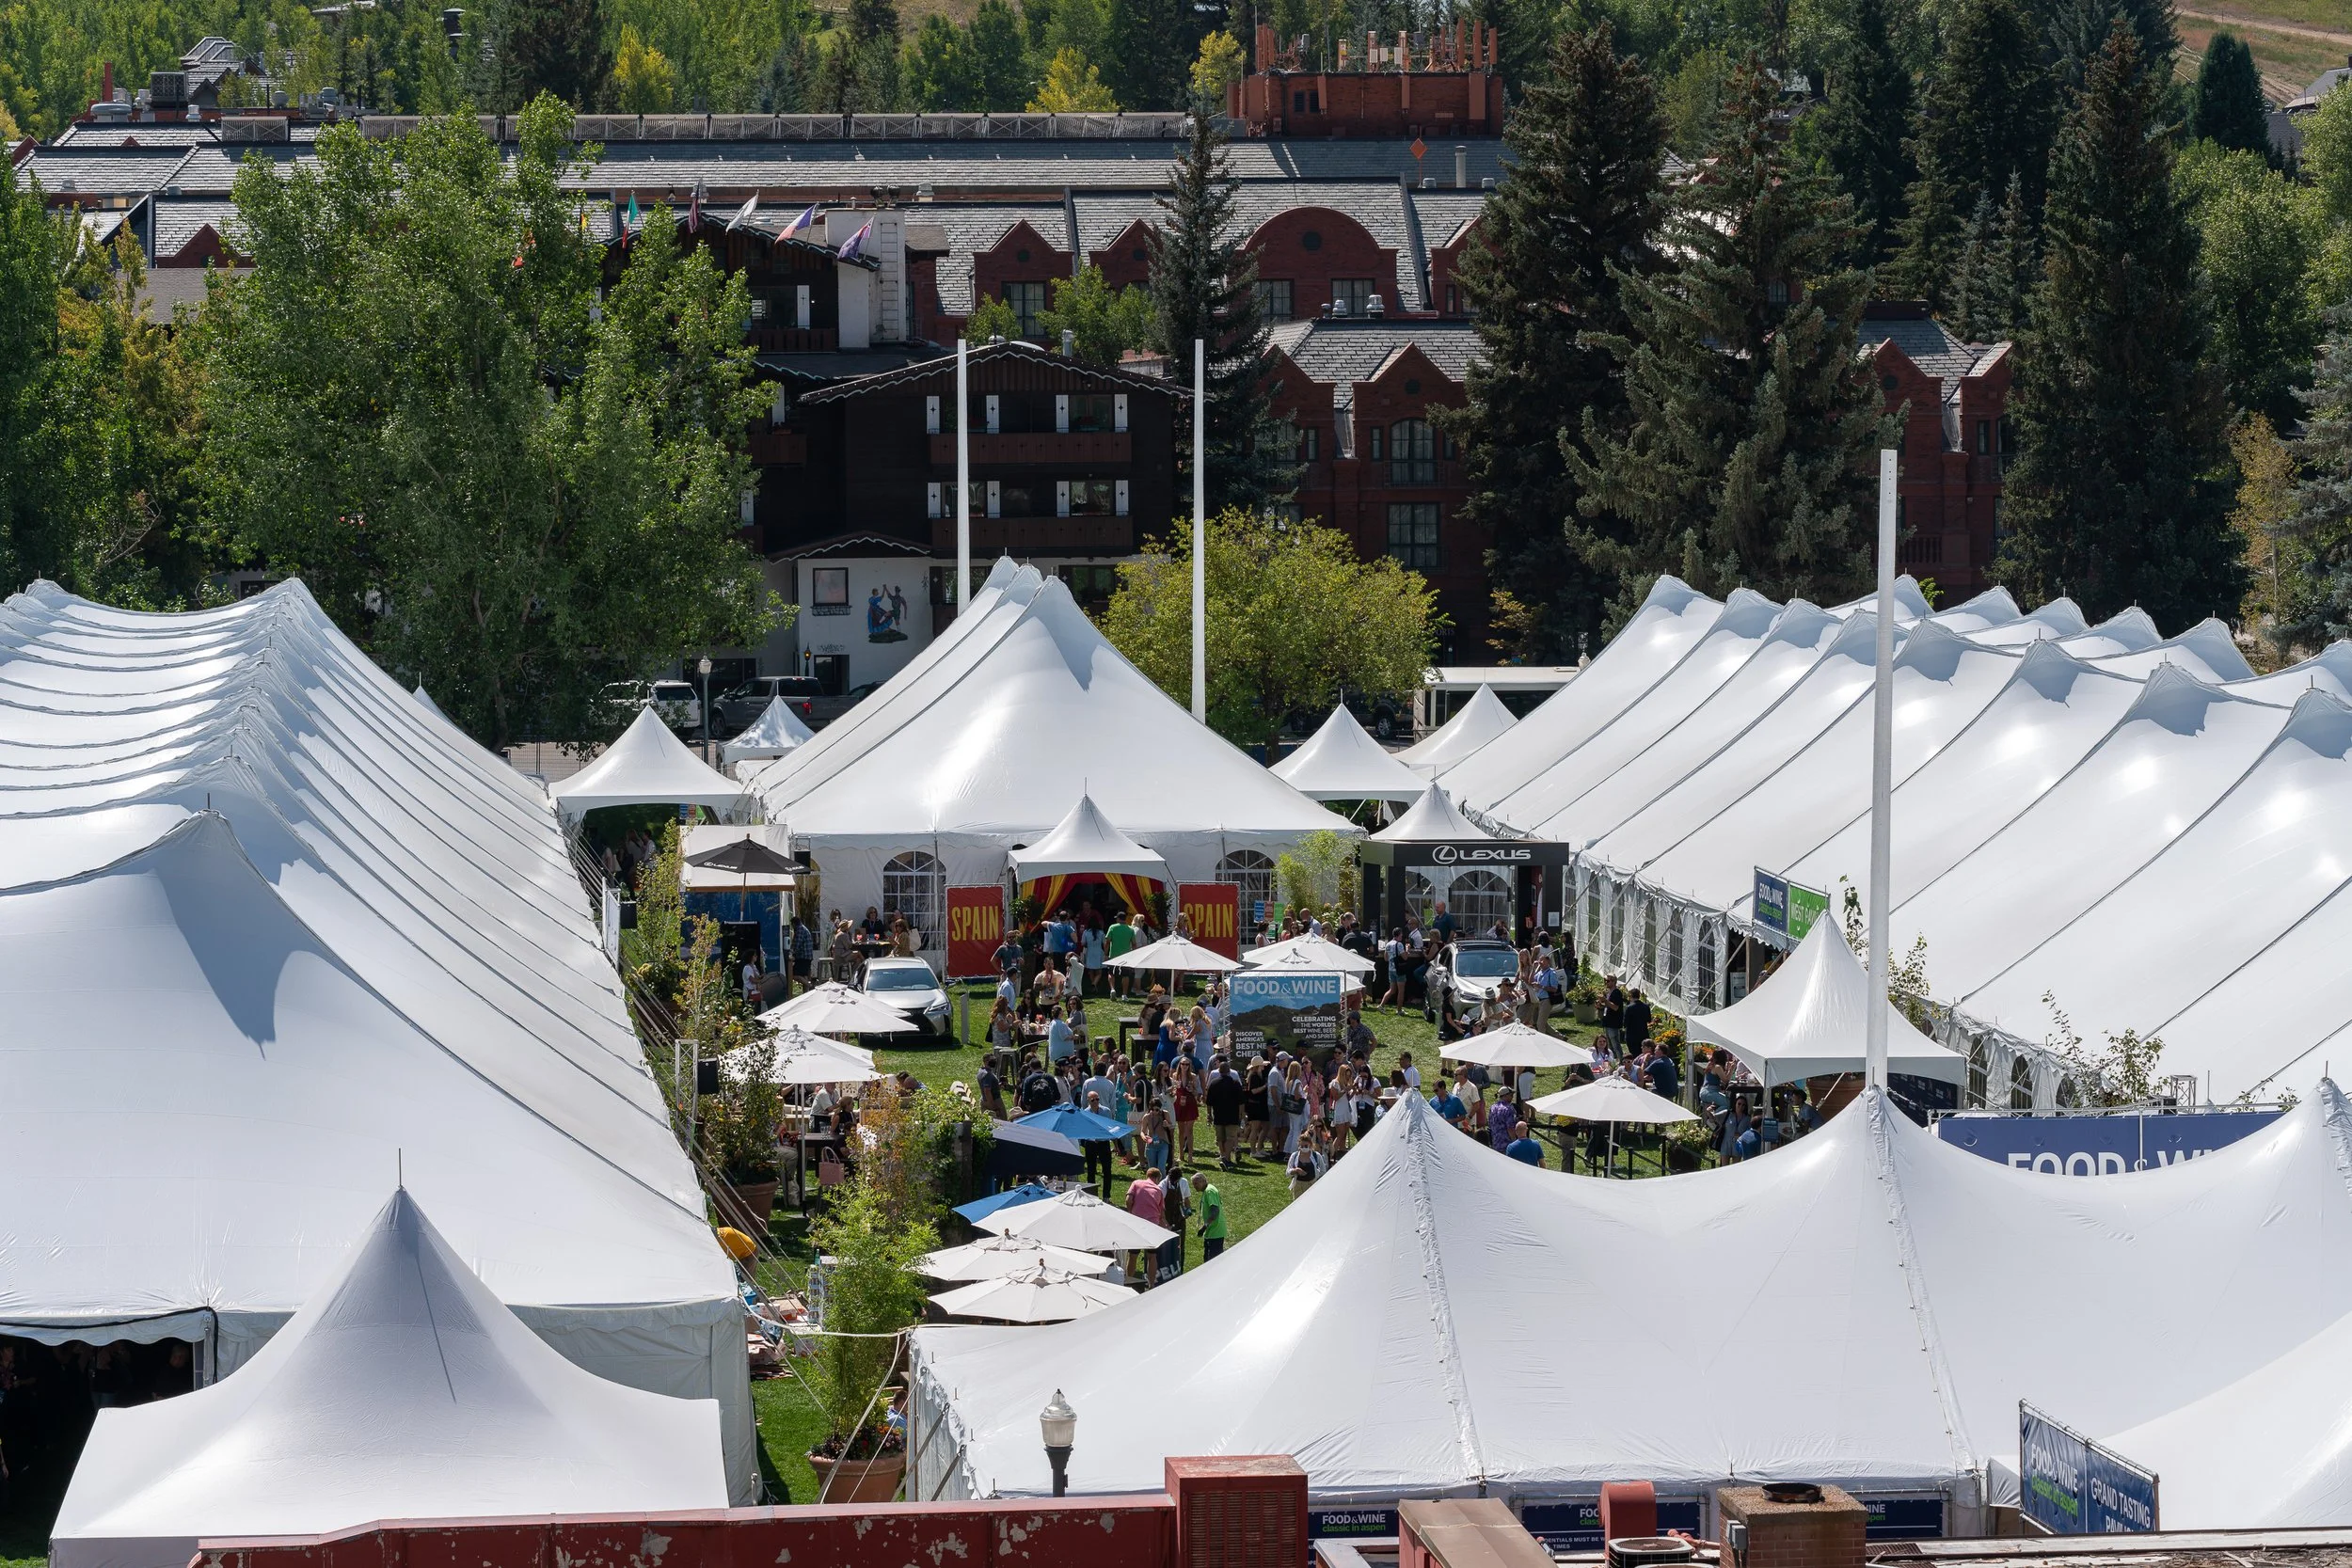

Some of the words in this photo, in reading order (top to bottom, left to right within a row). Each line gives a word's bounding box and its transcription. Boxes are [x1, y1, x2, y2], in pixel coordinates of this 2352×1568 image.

[1460, 849, 1532, 861] LEXUS
[951, 906, 999, 942] SPAIN
[1233, 979, 1337, 995] FOOD&WINE
[2090, 1477, 2118, 1512] GRAND
[2119, 1492, 2151, 1528] TASTING
[1322, 1513, 1386, 1524] FOOD&WINE
[1322, 1524, 1350, 1532] classic
[1360, 1524, 1386, 1532] aspen
